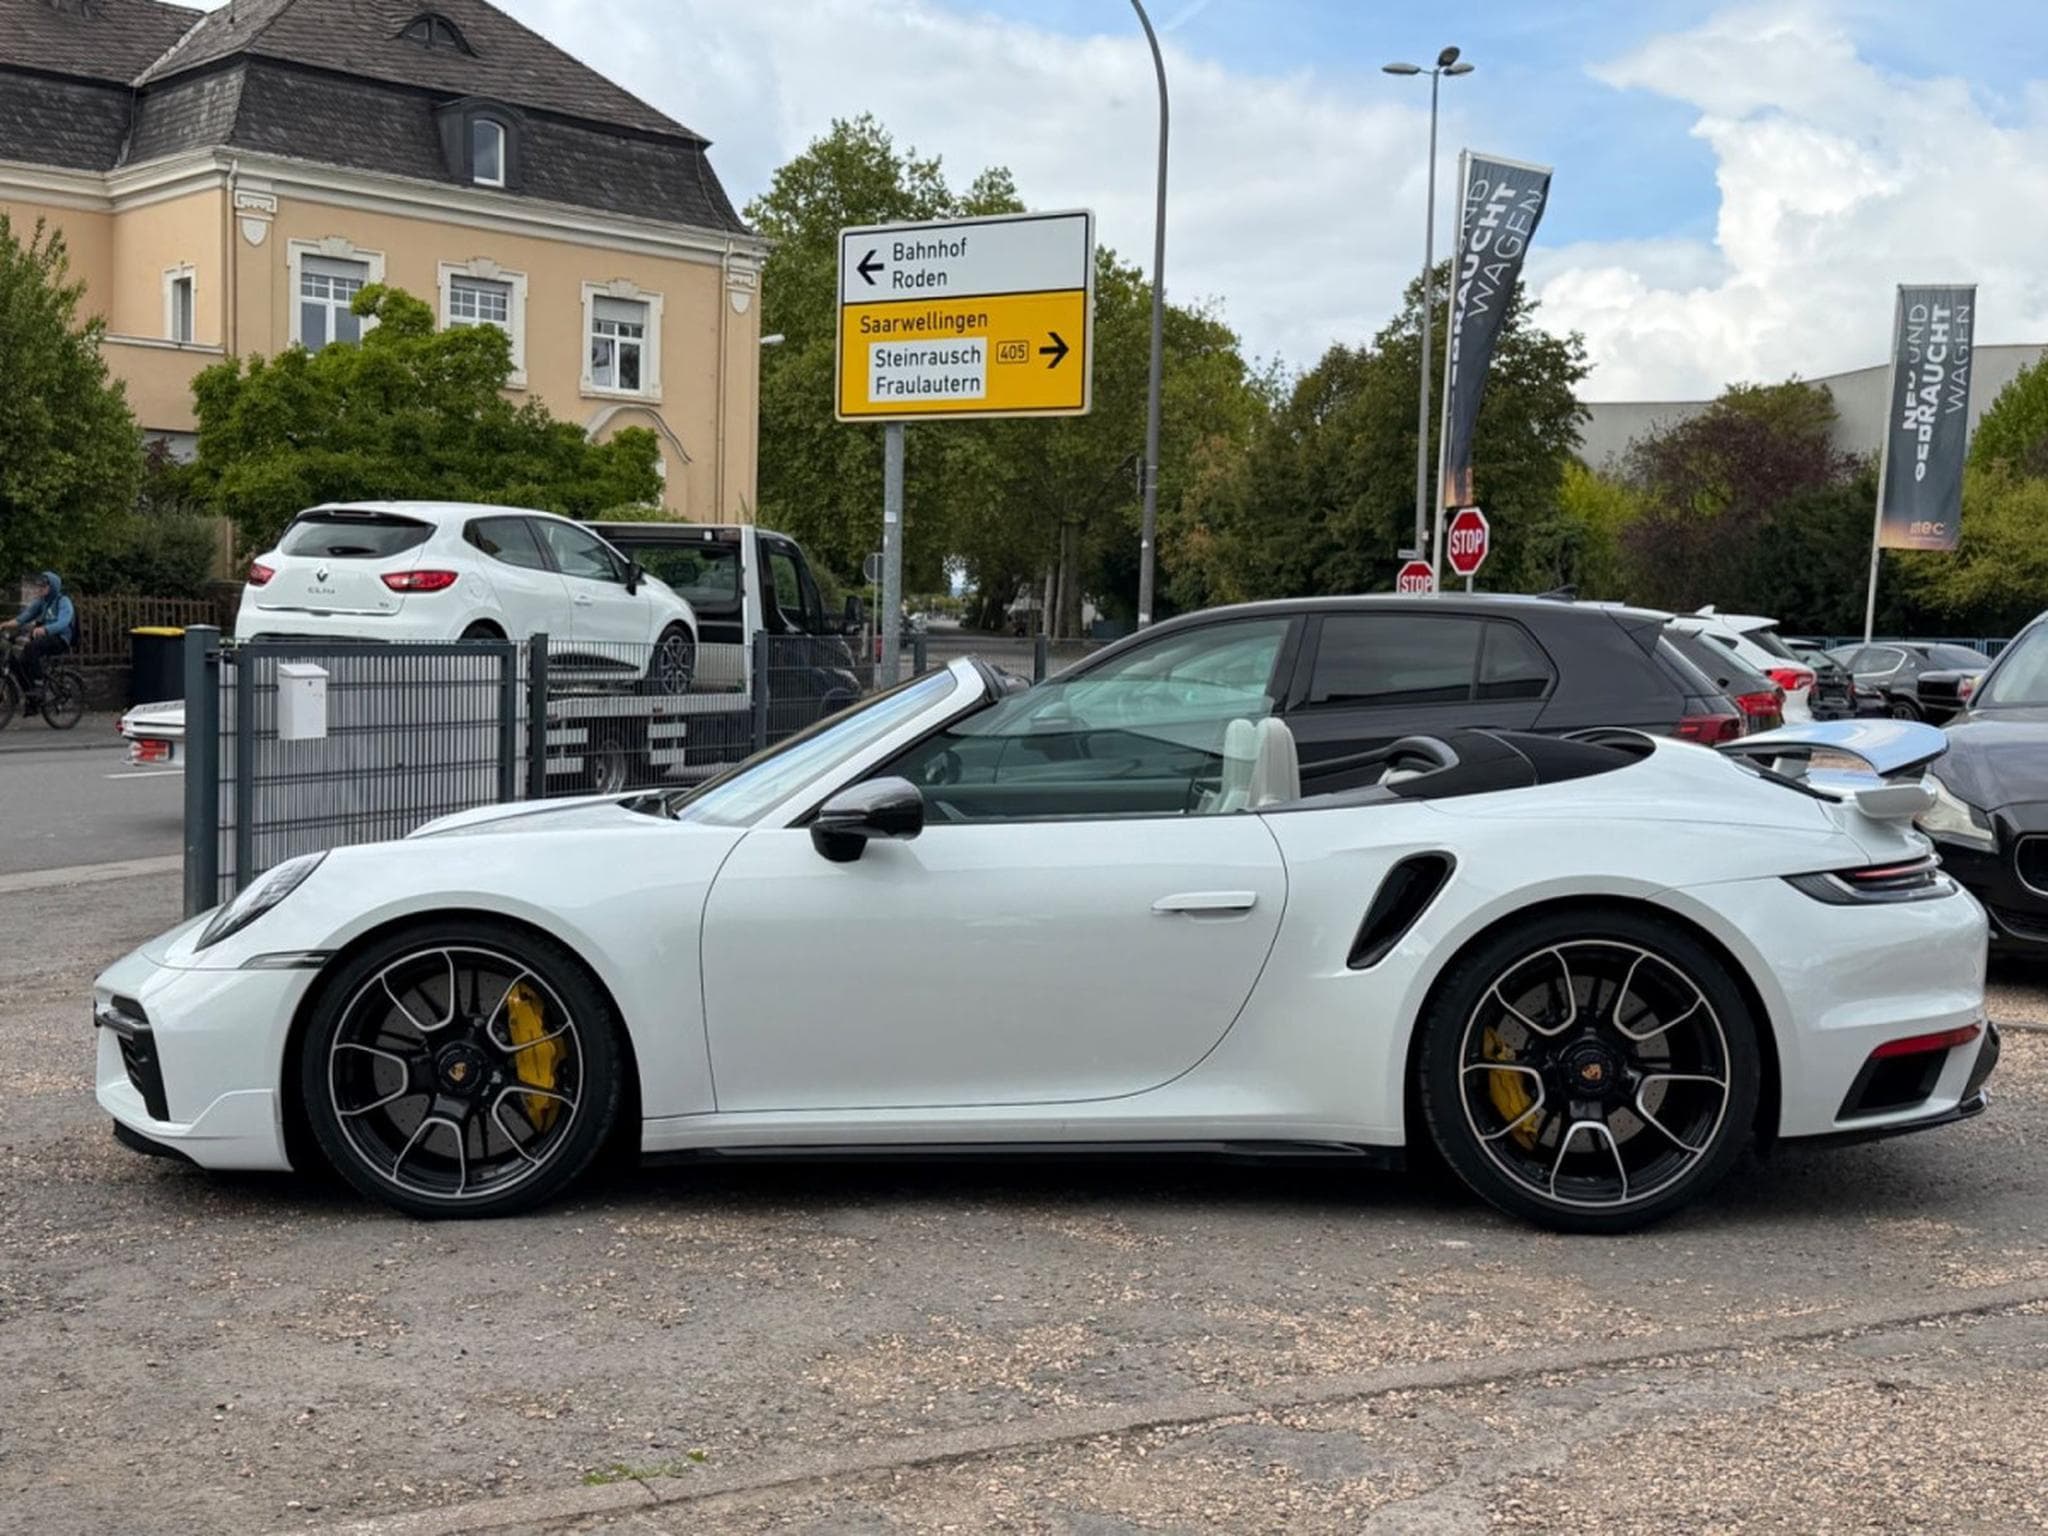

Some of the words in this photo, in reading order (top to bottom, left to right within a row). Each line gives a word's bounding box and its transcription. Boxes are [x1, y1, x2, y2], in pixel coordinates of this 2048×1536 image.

[893, 237, 967, 261] Bahnhof
[1467, 189, 1544, 318] WAGEN
[892, 269, 948, 289] Roden
[860, 311, 988, 334] Saarwellingen
[875, 345, 981, 368] Steinrausch
[1000, 344, 1026, 360] 405
[875, 375, 981, 395] Fraulautern
[1452, 528, 1484, 555] STOP
